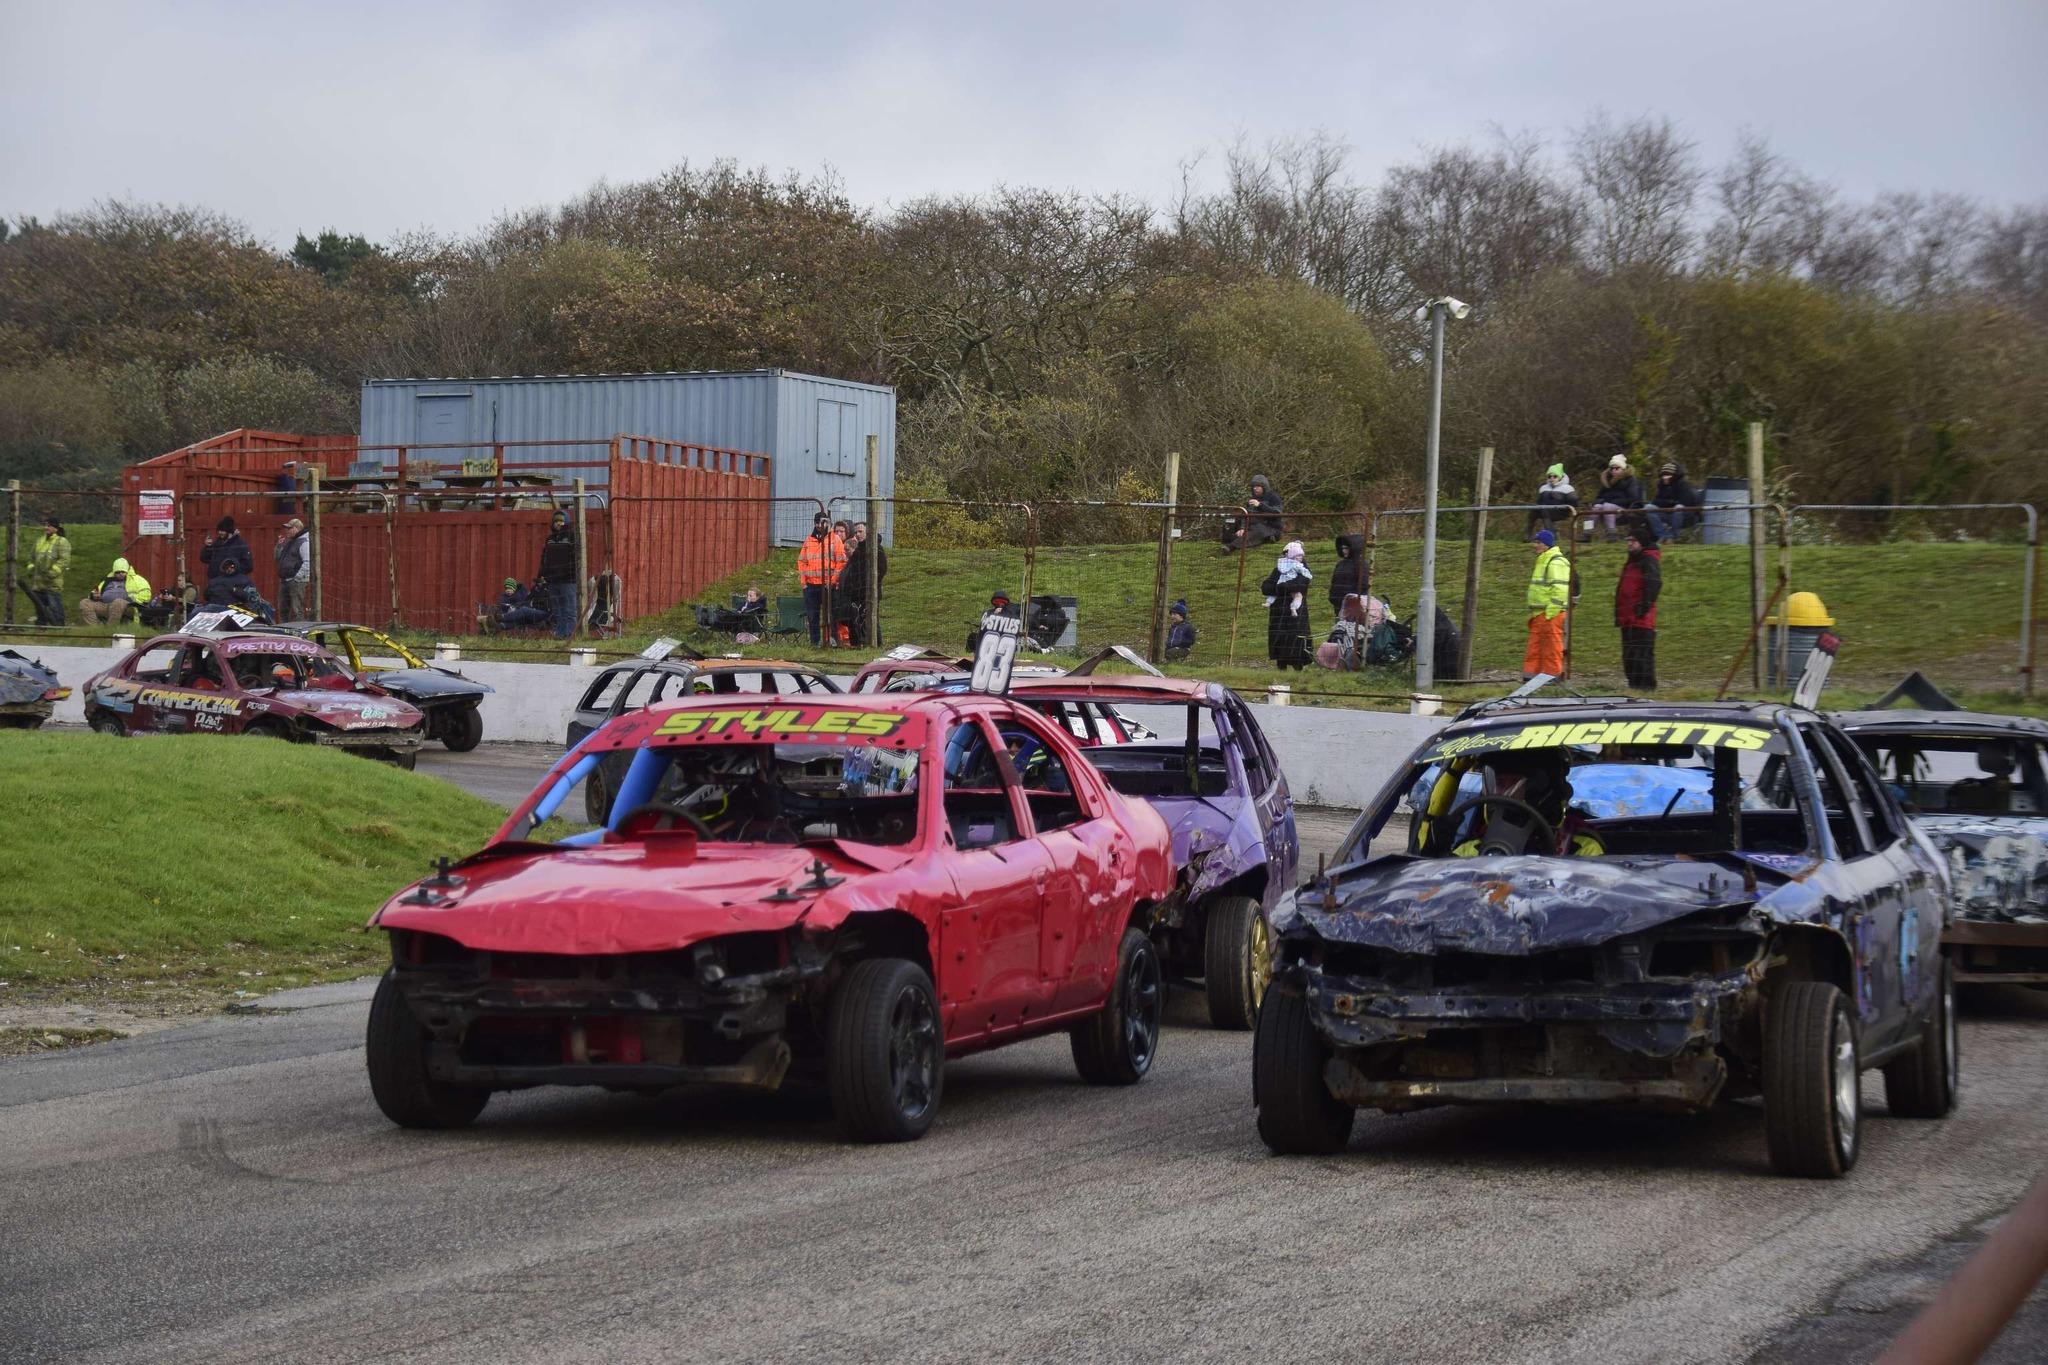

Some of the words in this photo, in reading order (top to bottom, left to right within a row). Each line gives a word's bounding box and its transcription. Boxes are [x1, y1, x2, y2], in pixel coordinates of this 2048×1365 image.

[986, 614, 1021, 634] STYLES
[227, 641, 286, 653] PRETTY
[289, 642, 318, 654] BOY
[971, 631, 1016, 694] 83
[138, 688, 243, 716] COMMERCIAL
[653, 710, 906, 736] STYLES
[1509, 721, 1774, 751] RICKETTS
